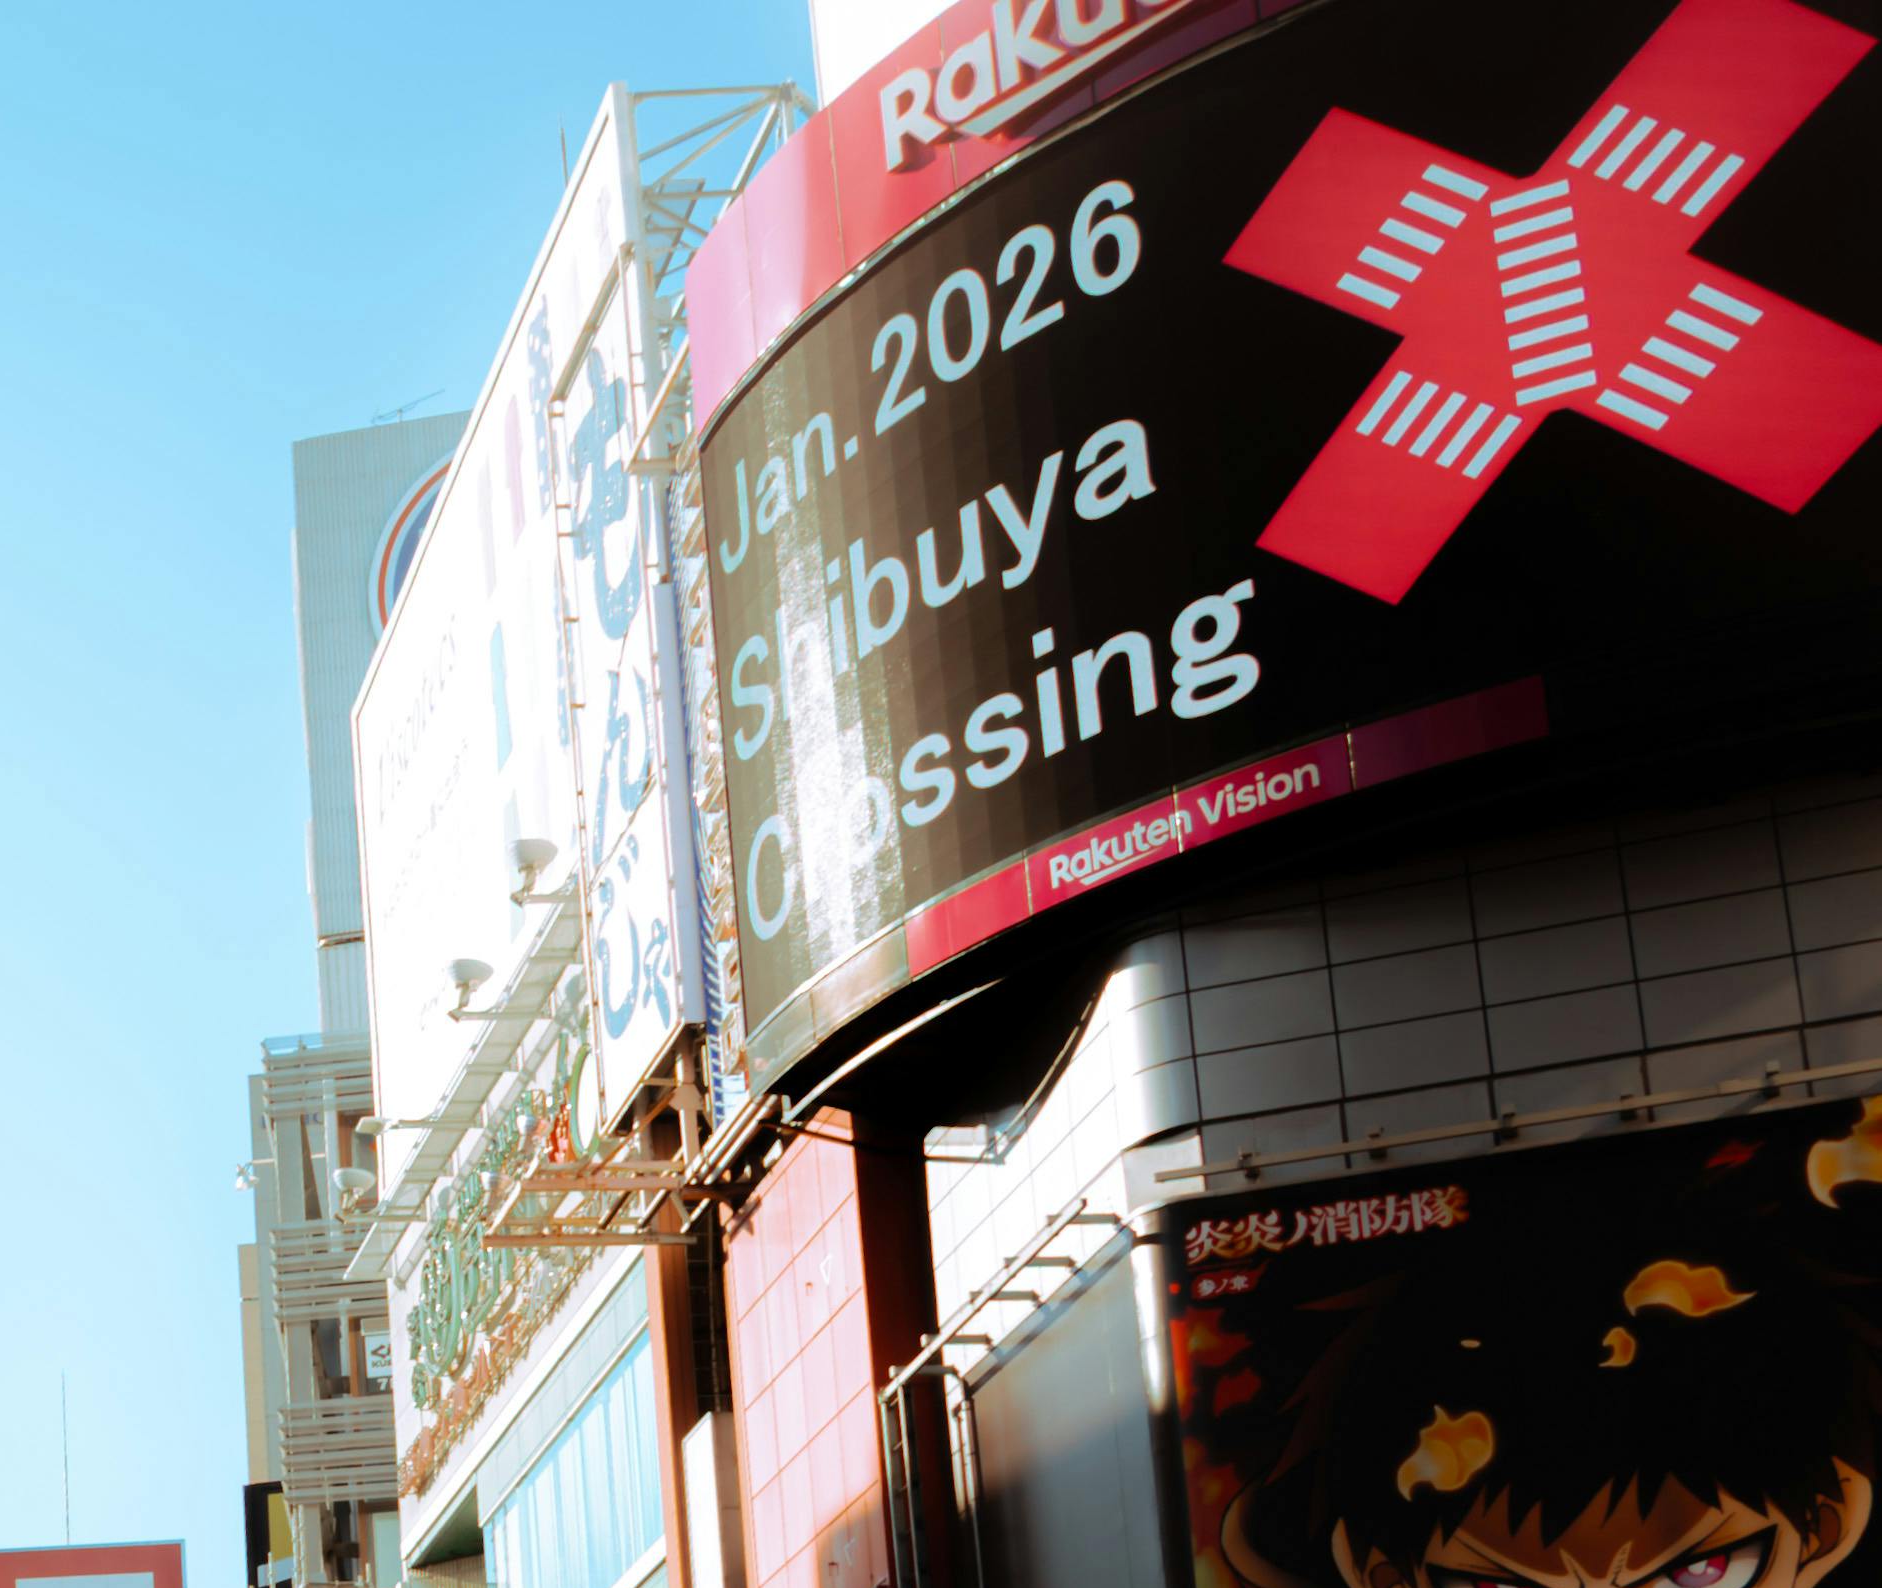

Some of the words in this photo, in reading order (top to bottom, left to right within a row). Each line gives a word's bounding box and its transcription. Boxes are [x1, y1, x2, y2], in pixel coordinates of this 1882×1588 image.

[718, 409, 859, 574] Jan.
[871, 179, 1141, 436] 2026
[731, 417, 1157, 762] Shibuya
[1048, 807, 1193, 889] Rakuten
[1197, 757, 1323, 822] Vision
[1185, 1184, 1469, 1266] 炎炎ノ消防隊
